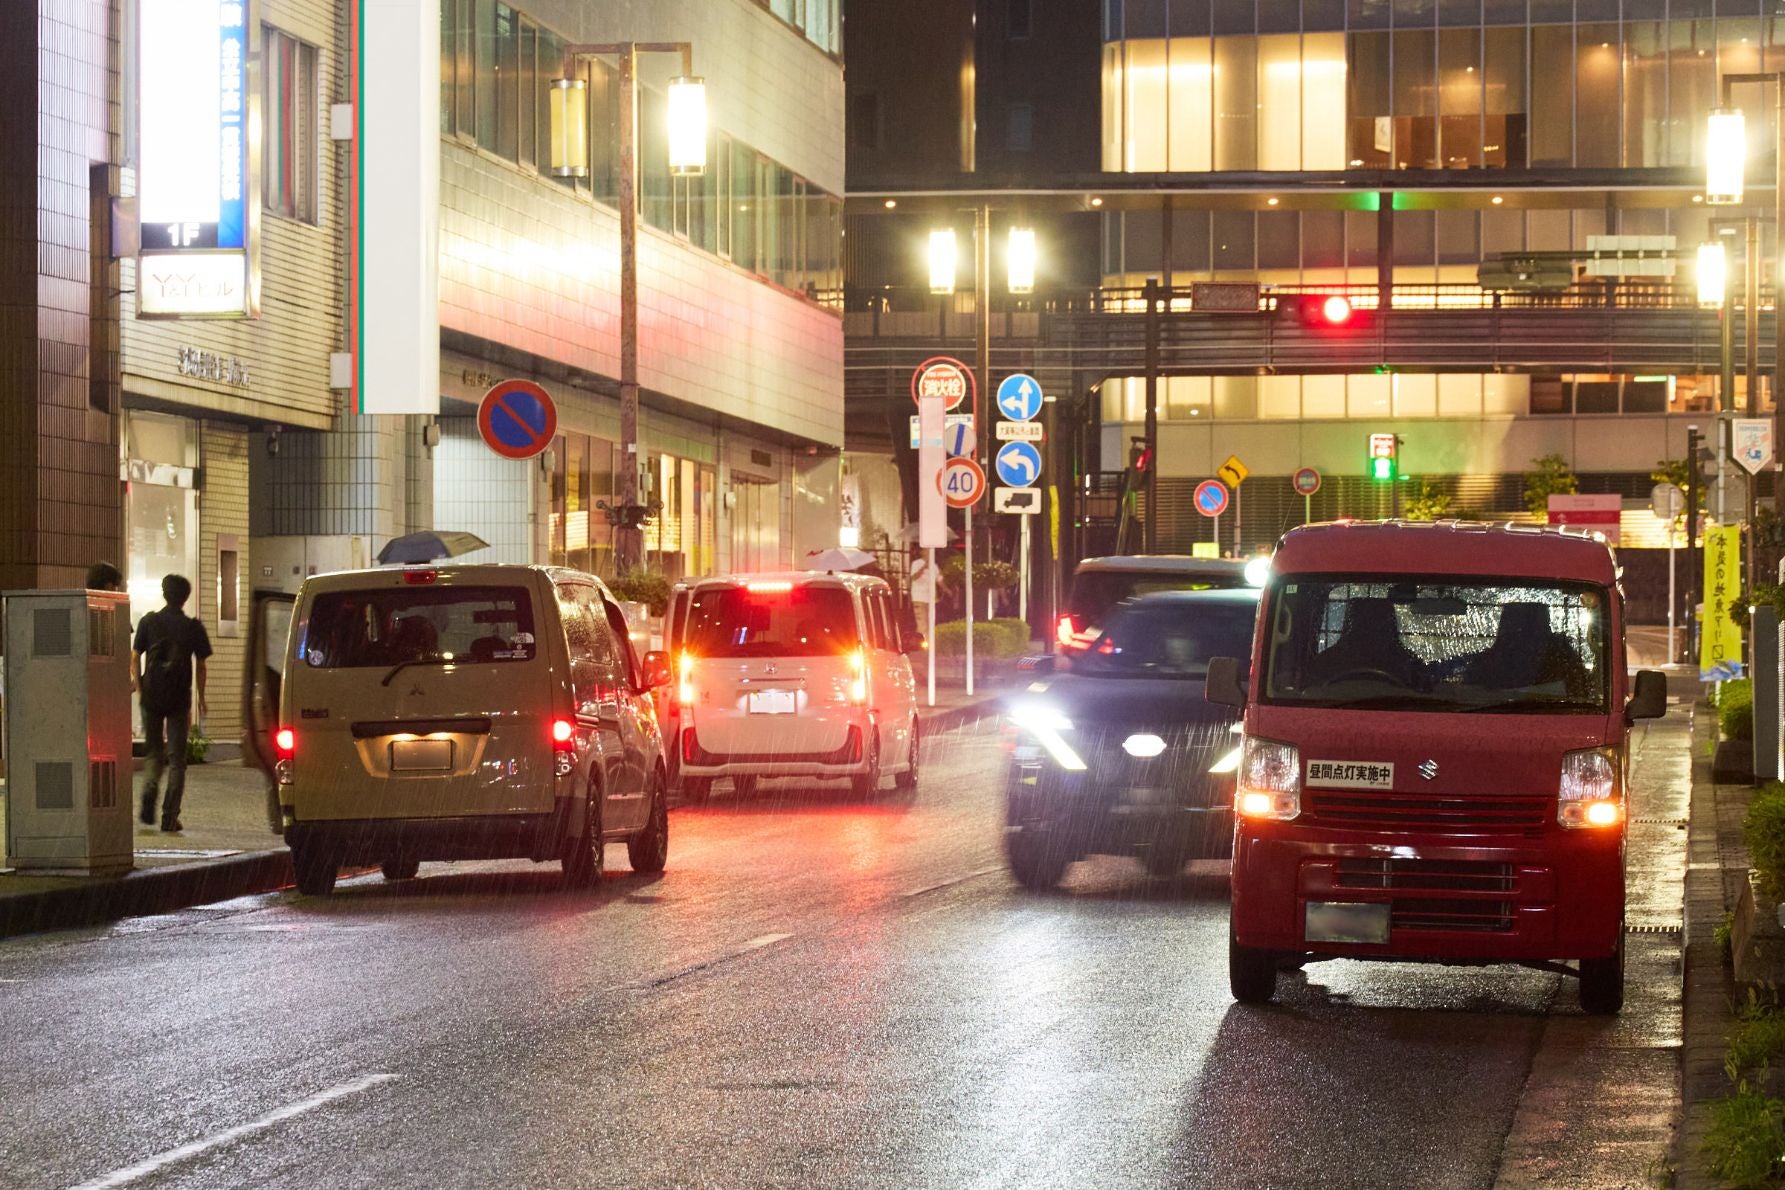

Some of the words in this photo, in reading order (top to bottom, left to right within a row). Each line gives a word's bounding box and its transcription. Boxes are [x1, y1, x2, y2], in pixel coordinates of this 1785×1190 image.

[167, 223, 200, 246] 1F
[924, 379, 961, 397] 消火栓
[947, 472, 973, 493] 40
[1309, 763, 1391, 782] 昼間点灯実施中
